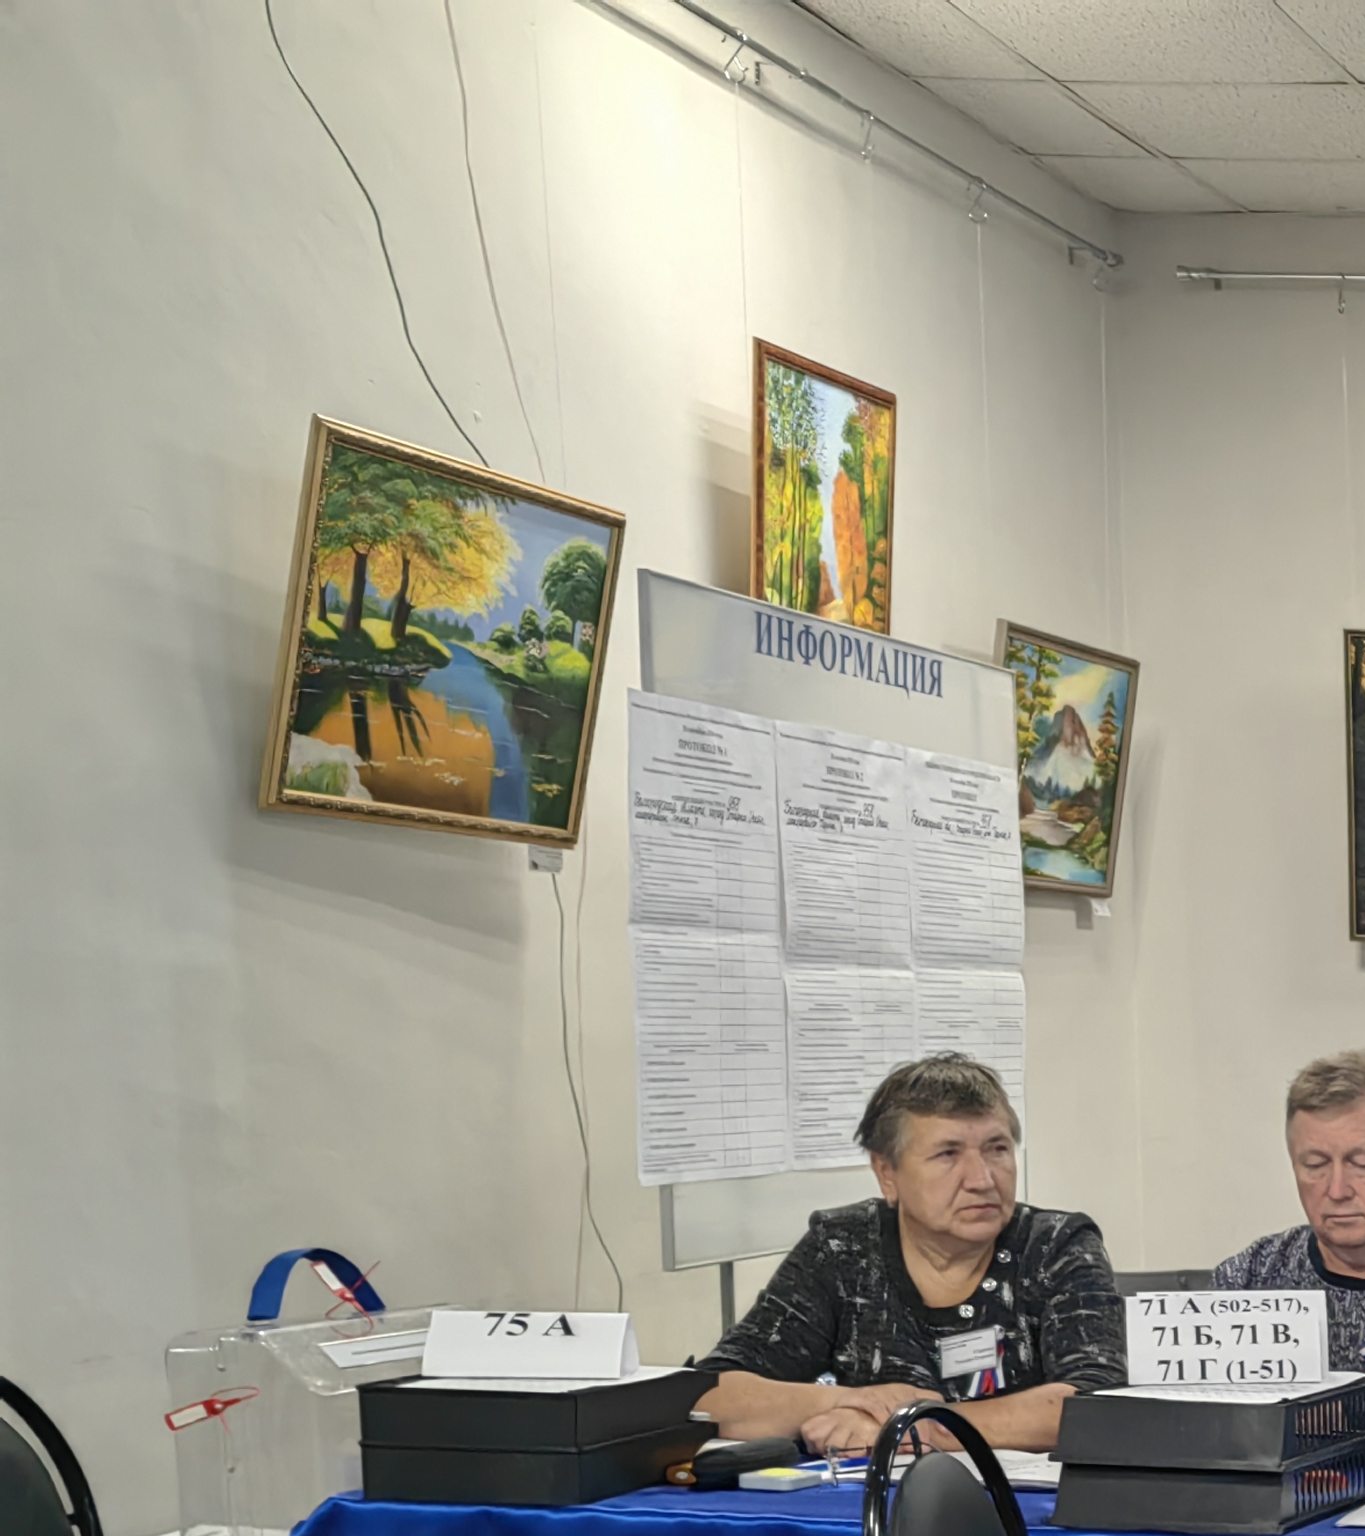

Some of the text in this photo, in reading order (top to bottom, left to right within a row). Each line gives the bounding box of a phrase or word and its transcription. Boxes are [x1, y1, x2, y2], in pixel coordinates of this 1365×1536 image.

[754, 610, 943, 700] ИНФОРМАЦИЯ
[1139, 1298, 1168, 1316] 71
[1210, 1298, 1310, 1317] (502-517),
[483, 1312, 531, 1336] 75
[1152, 1326, 1182, 1347] 71
[1194, 1325, 1222, 1349] Б,
[1230, 1324, 1259, 1345] 71
[1157, 1358, 1297, 1384] 71 Г (1-51)
